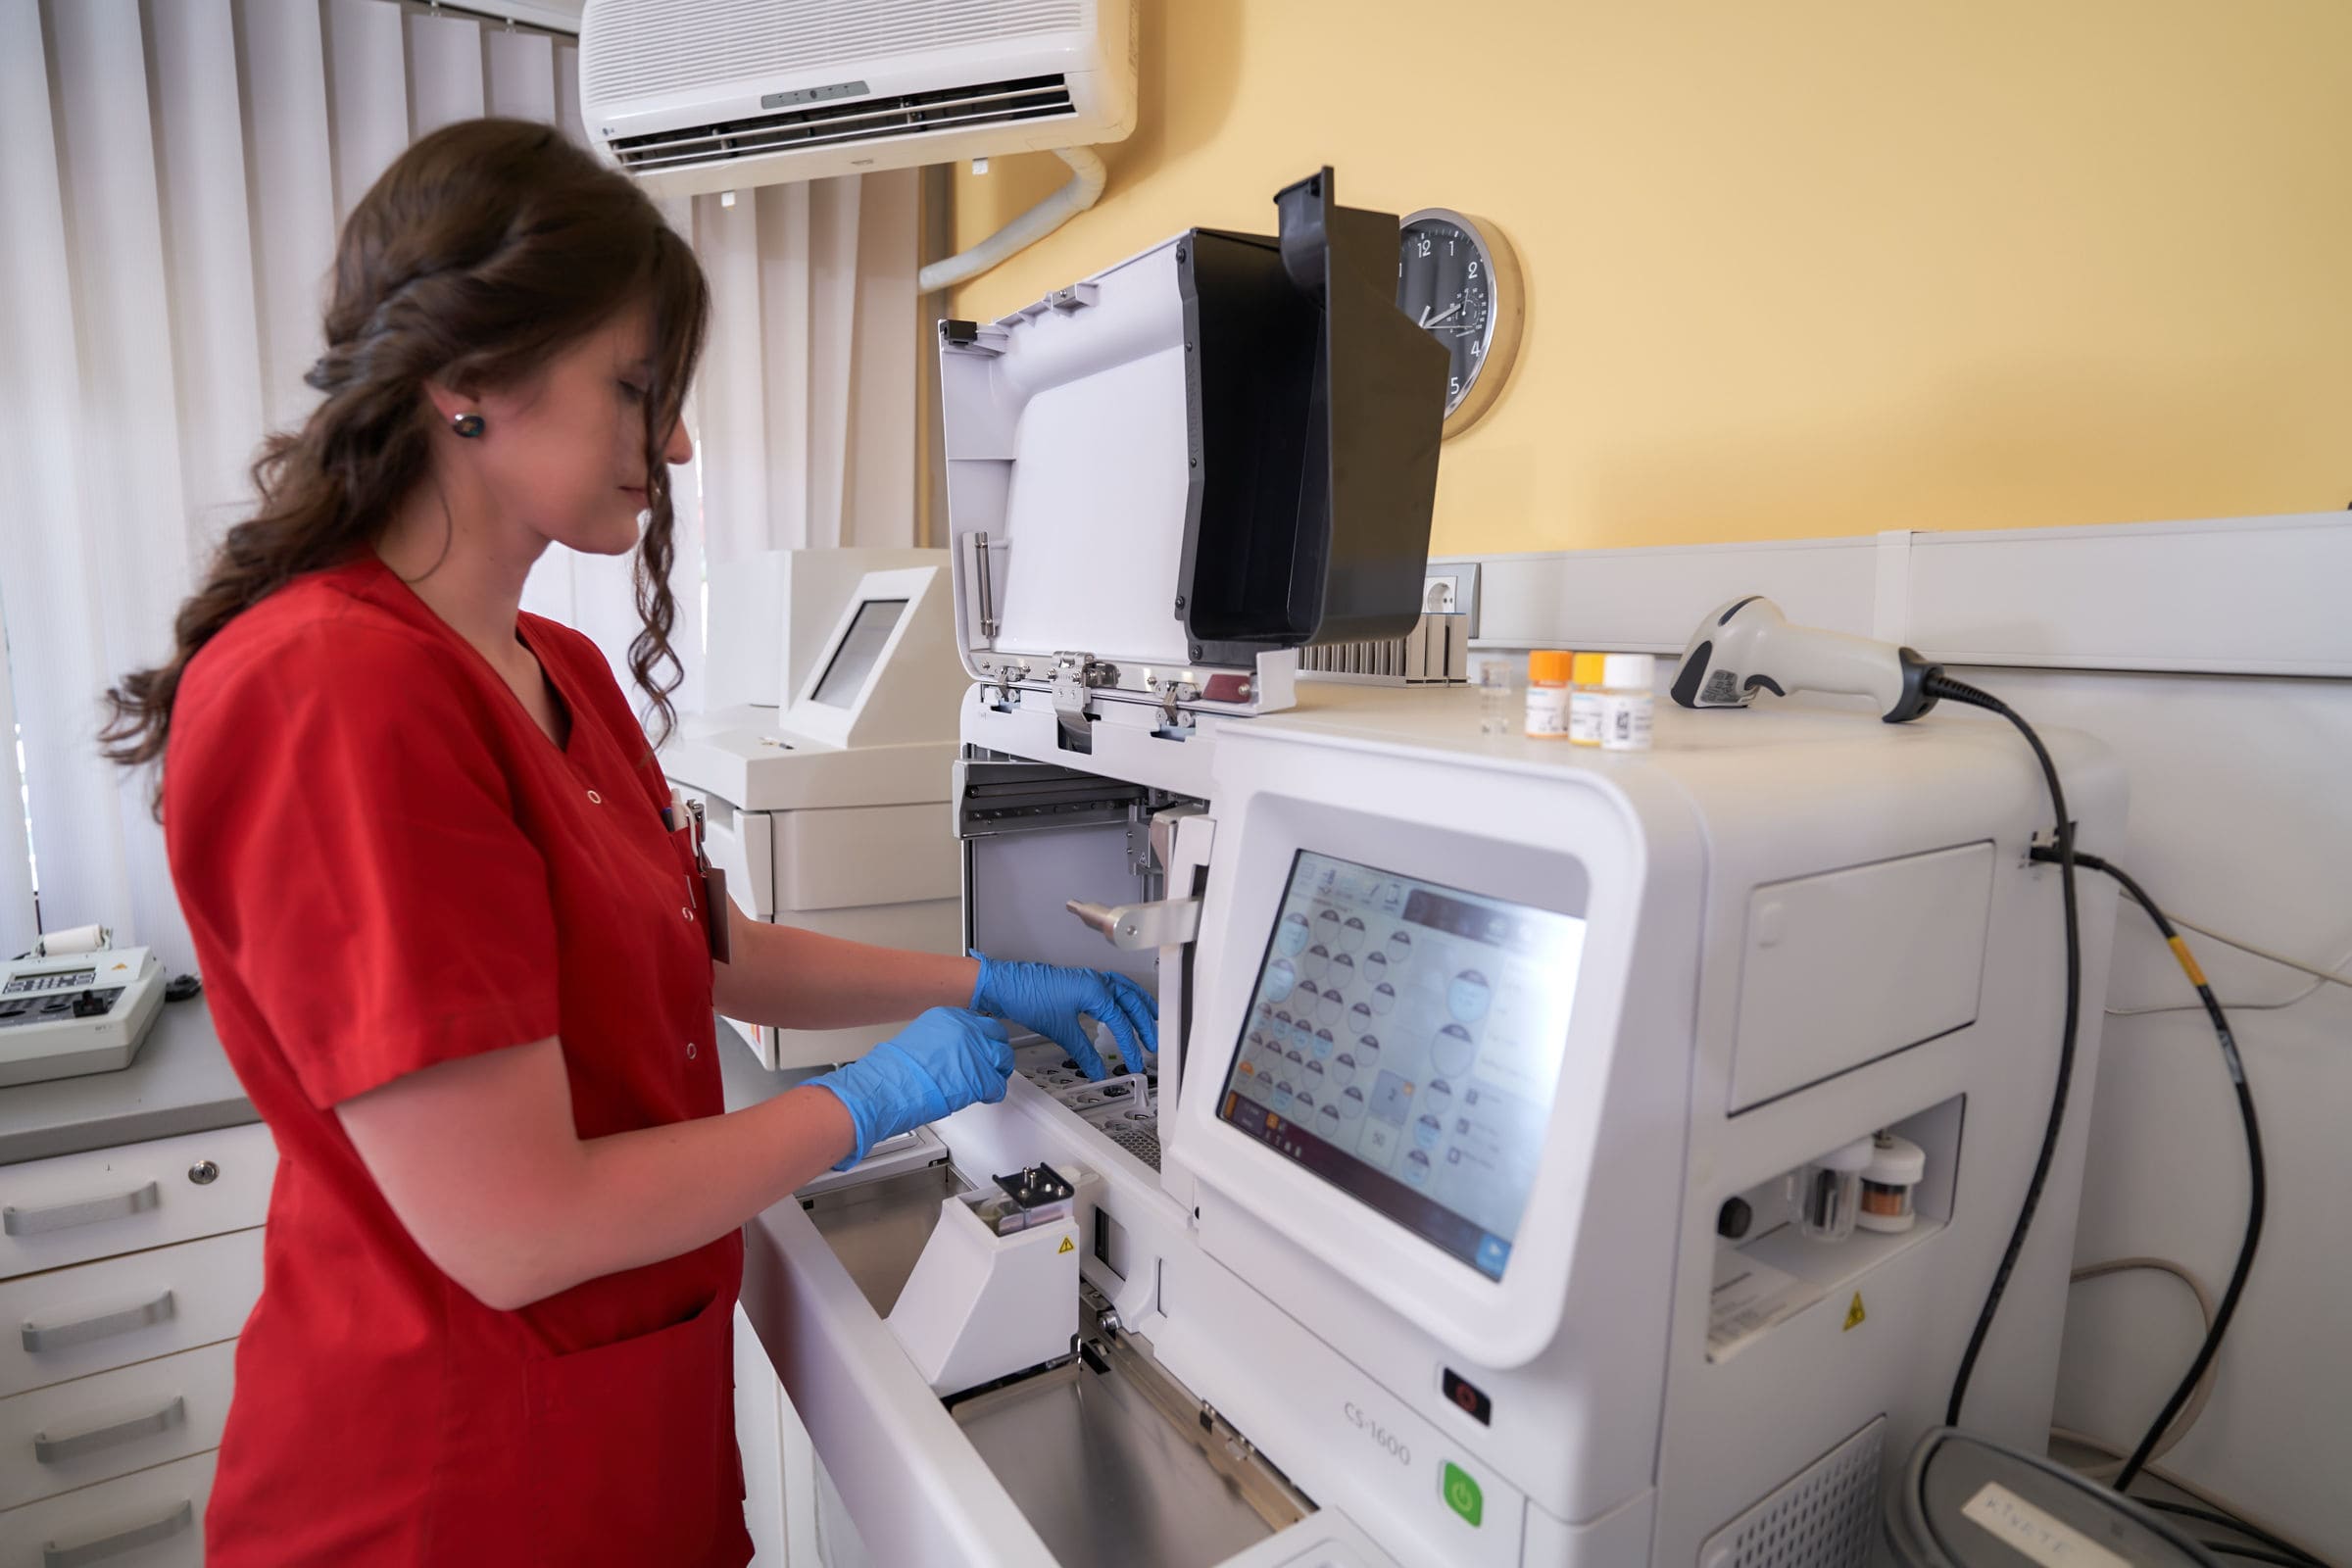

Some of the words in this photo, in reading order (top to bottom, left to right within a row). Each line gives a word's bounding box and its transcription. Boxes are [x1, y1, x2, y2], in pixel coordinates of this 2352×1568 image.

[1417, 239, 1431, 258] 12
[1448, 240, 1454, 257] 1
[1468, 261, 1478, 279] 2
[1470, 339, 1481, 357] 4
[1450, 376, 1460, 395] 5
[1344, 1400, 1411, 1466] CS-1600
